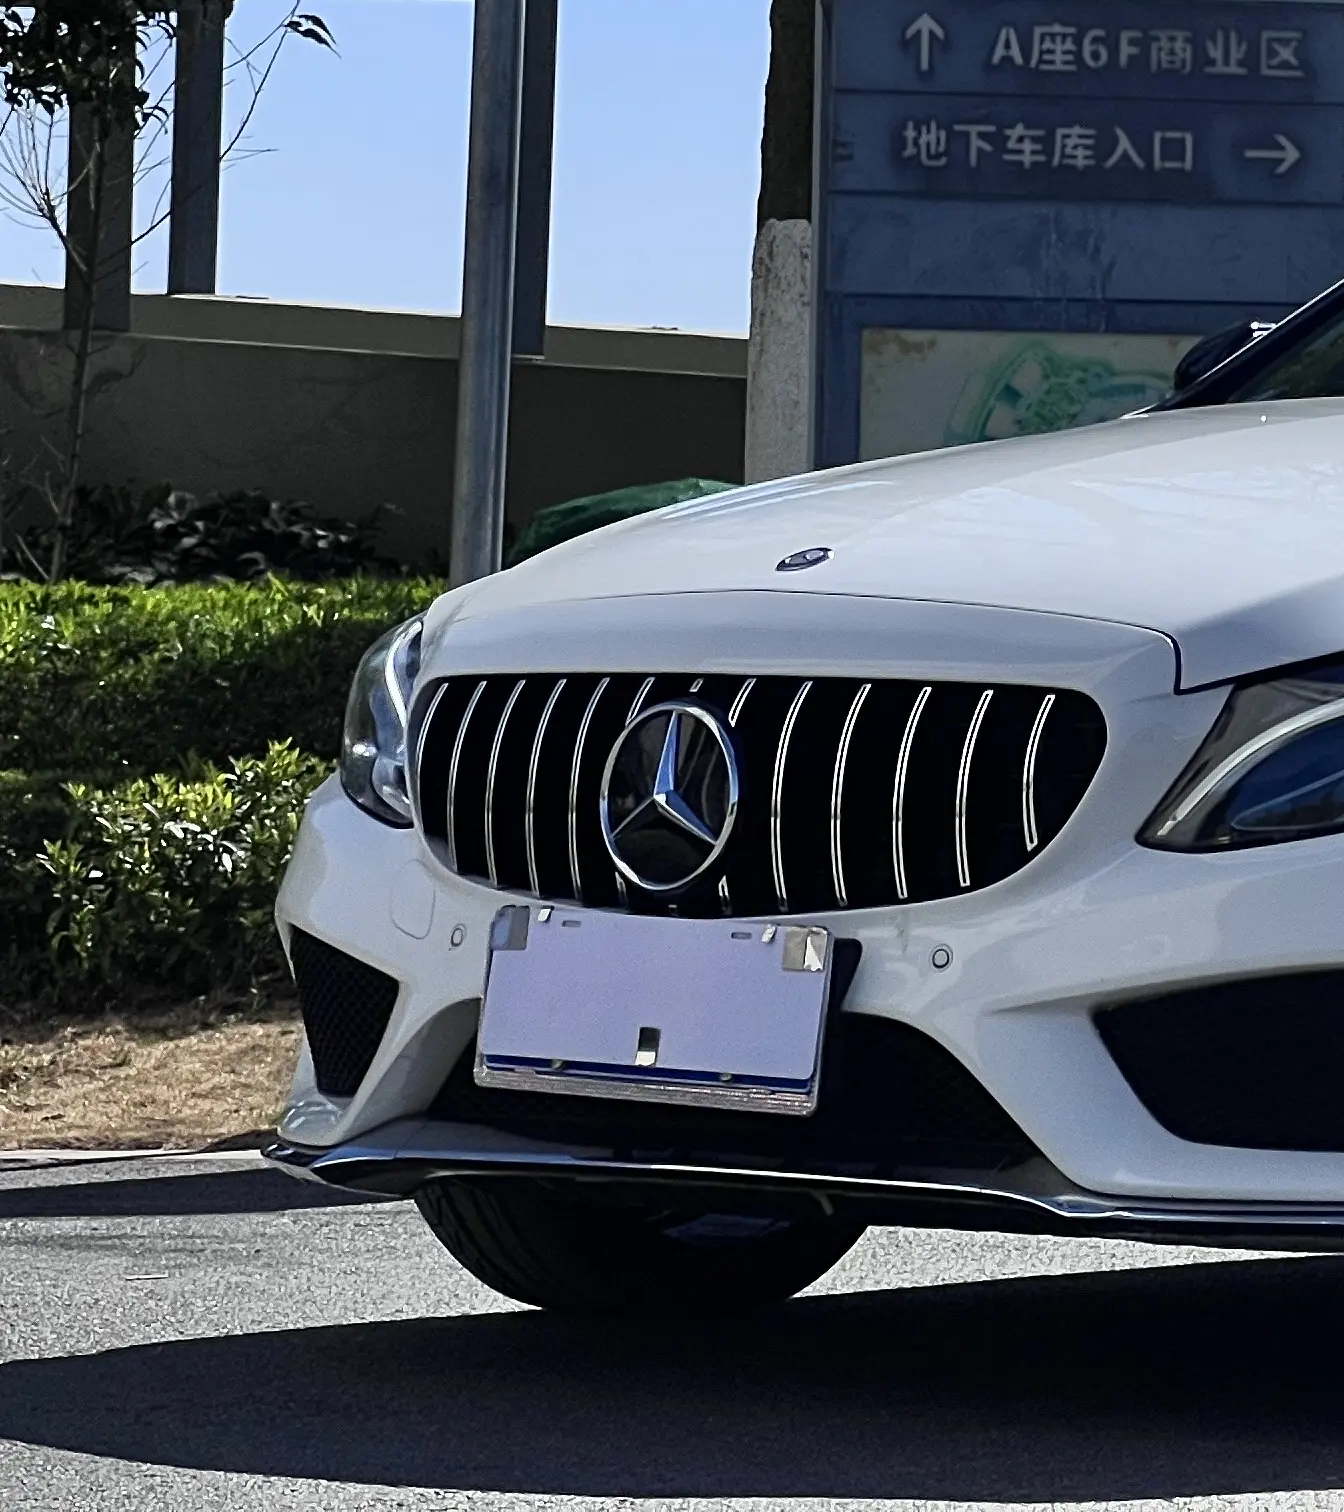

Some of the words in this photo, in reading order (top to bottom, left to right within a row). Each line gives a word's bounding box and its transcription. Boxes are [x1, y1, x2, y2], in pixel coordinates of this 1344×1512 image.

[991, 22, 1306, 79] A座6F商业区
[901, 119, 1195, 173] 地下车库入口
